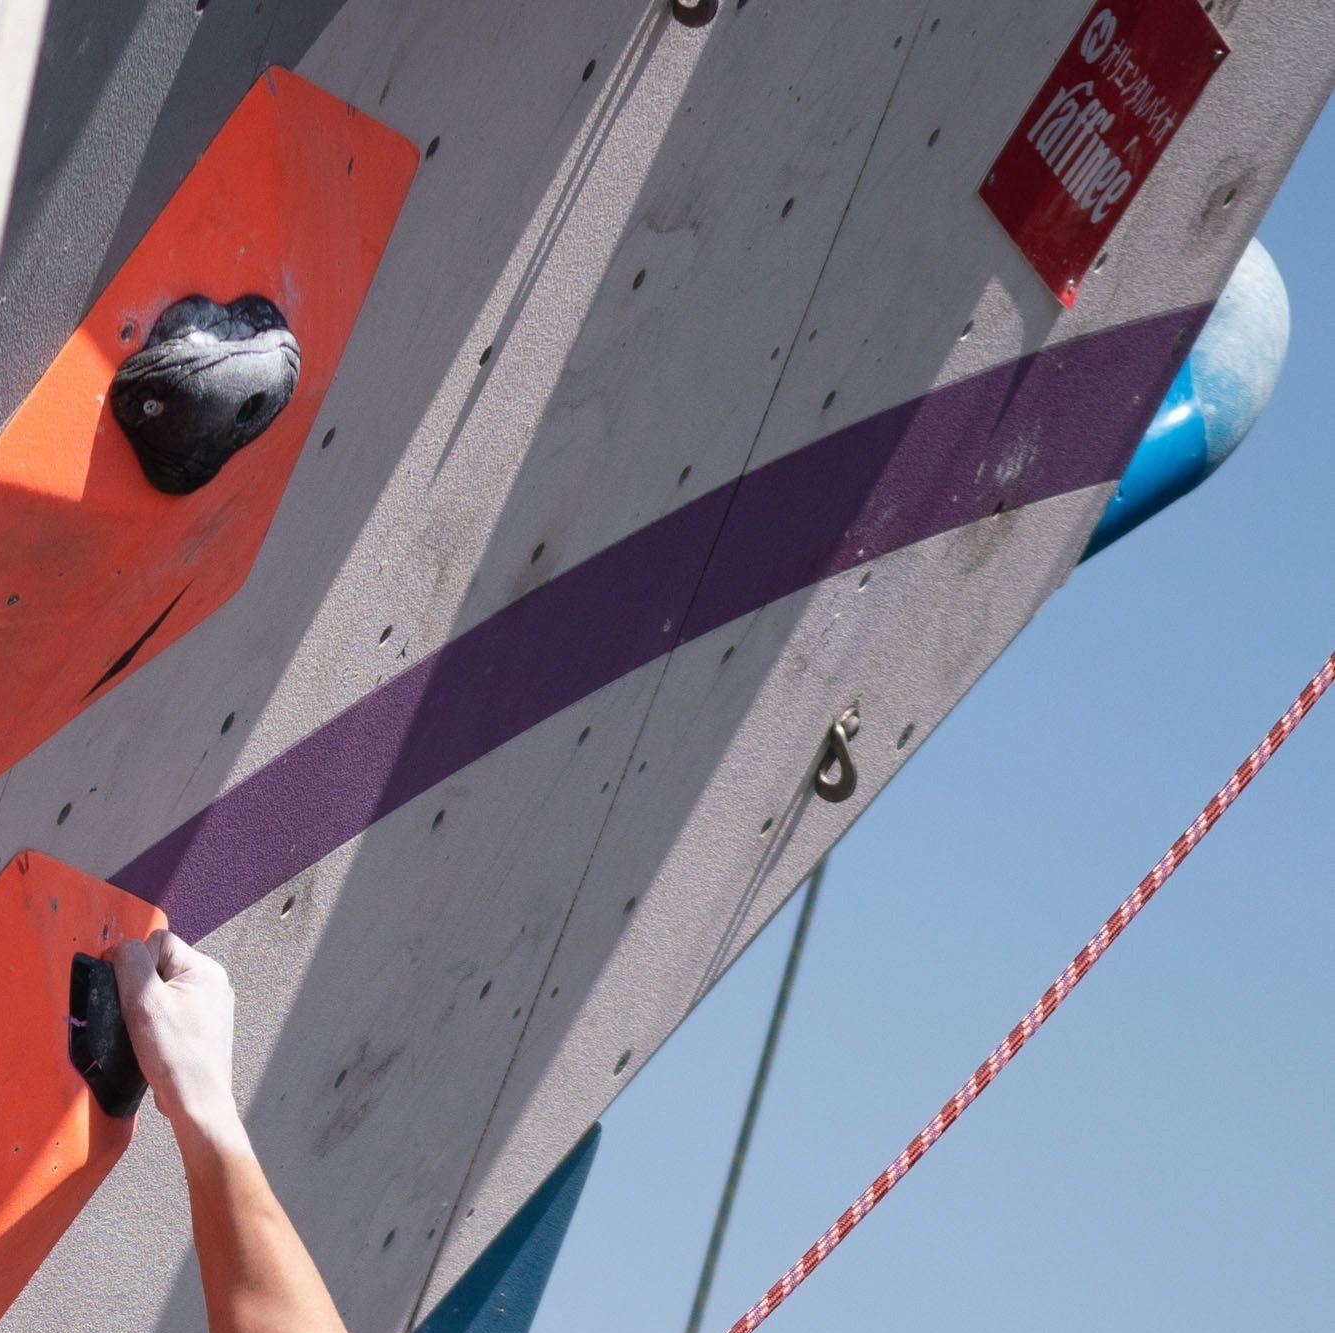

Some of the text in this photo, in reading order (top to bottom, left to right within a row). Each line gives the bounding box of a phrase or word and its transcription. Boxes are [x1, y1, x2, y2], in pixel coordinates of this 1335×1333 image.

[1098, 37, 1178, 146] オリエンタルバイオ
